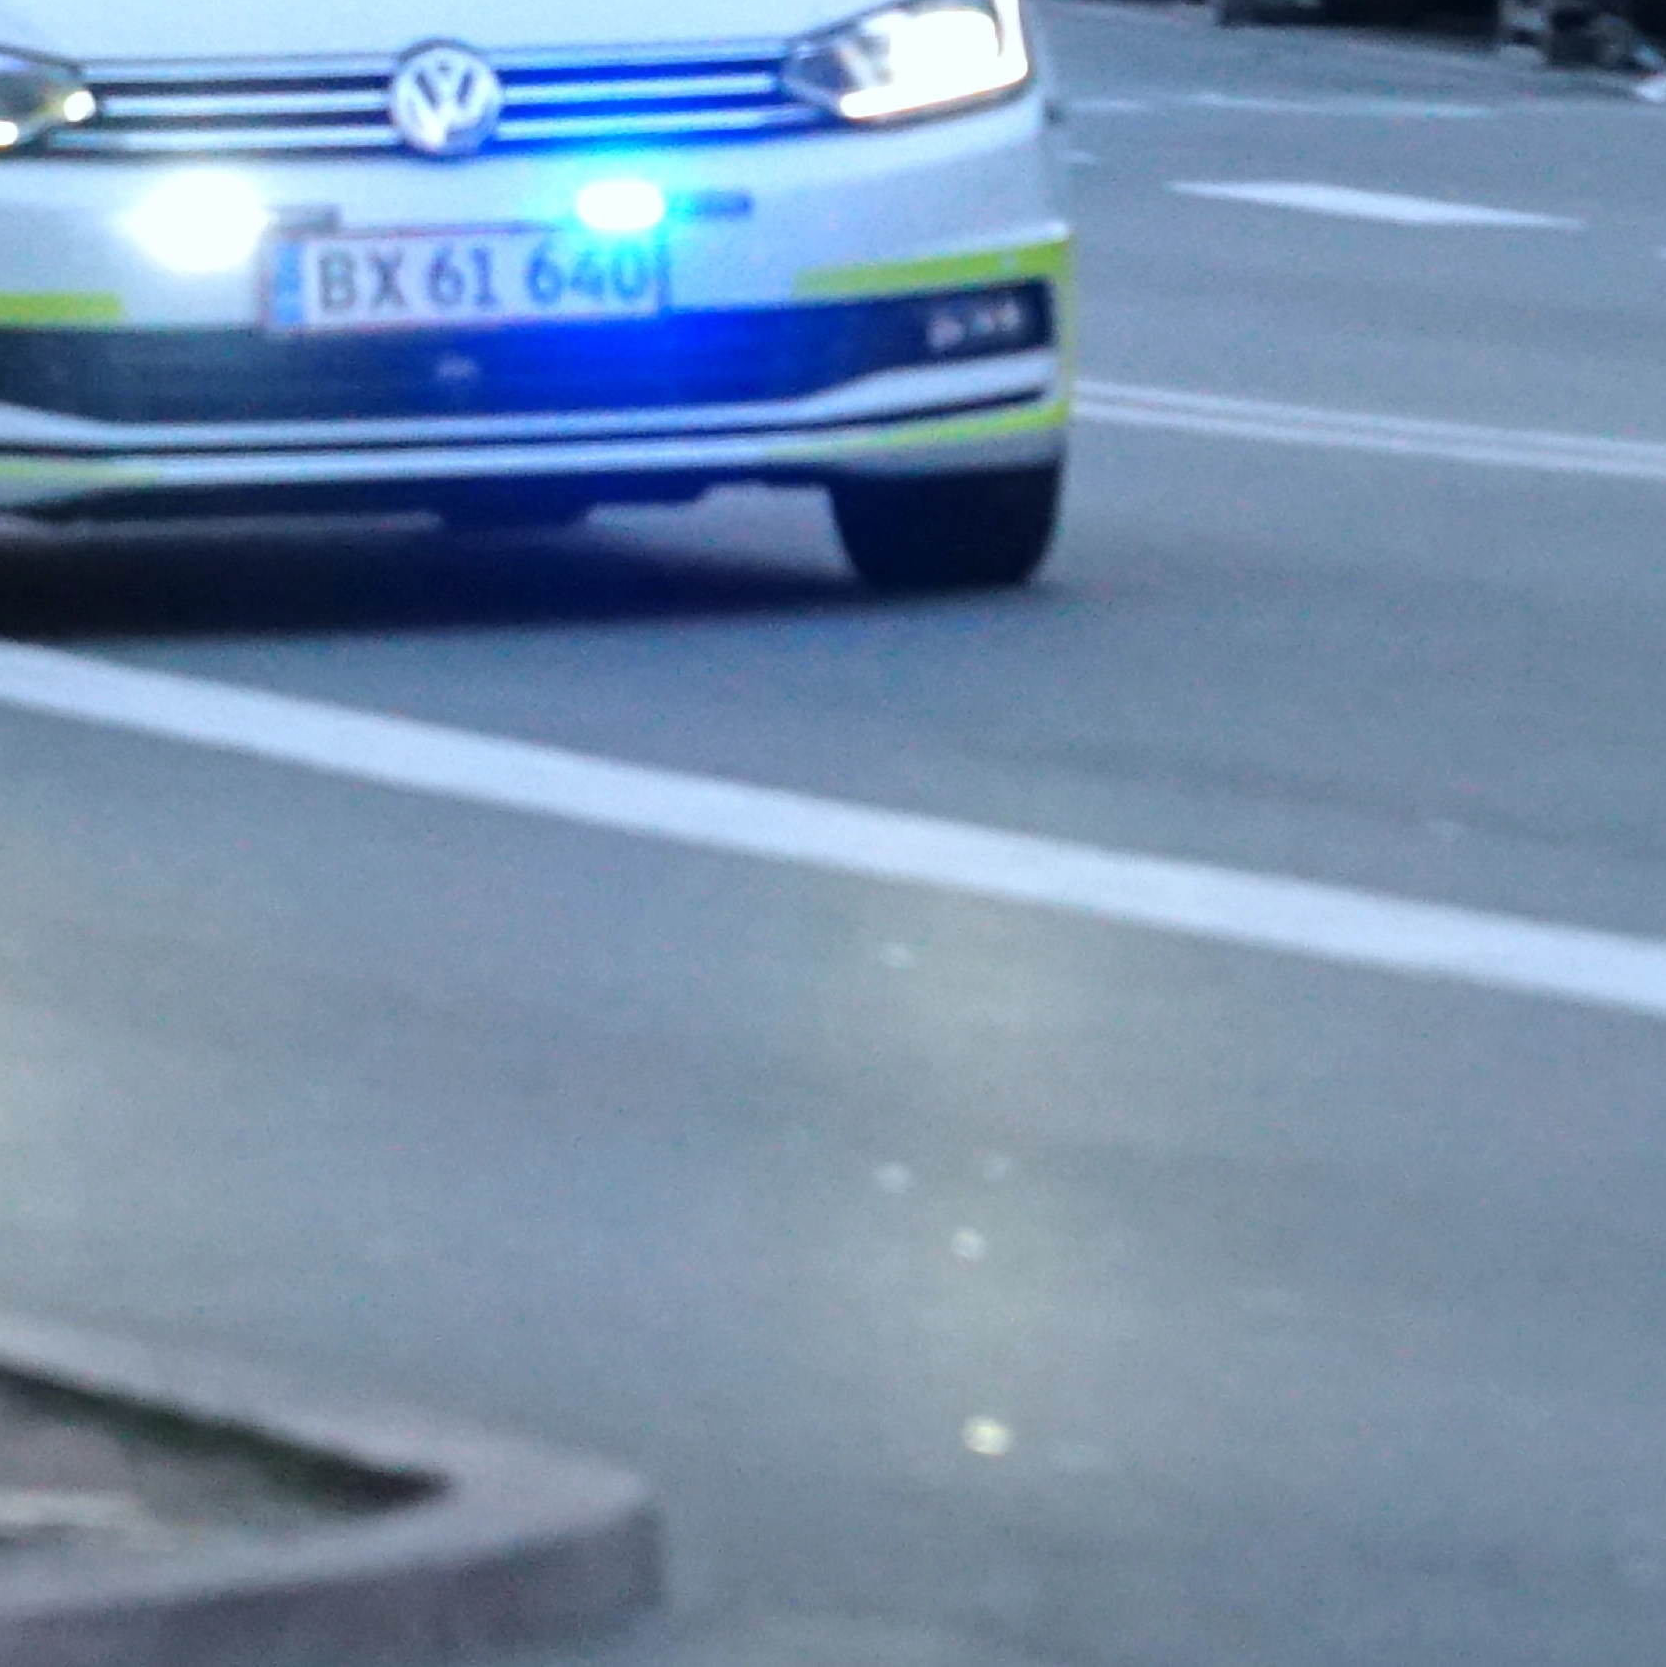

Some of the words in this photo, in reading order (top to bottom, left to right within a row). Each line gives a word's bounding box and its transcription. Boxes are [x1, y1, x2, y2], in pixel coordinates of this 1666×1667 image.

[318, 249, 405, 310] BX
[429, 245, 495, 308] 61
[526, 245, 651, 306] 640
